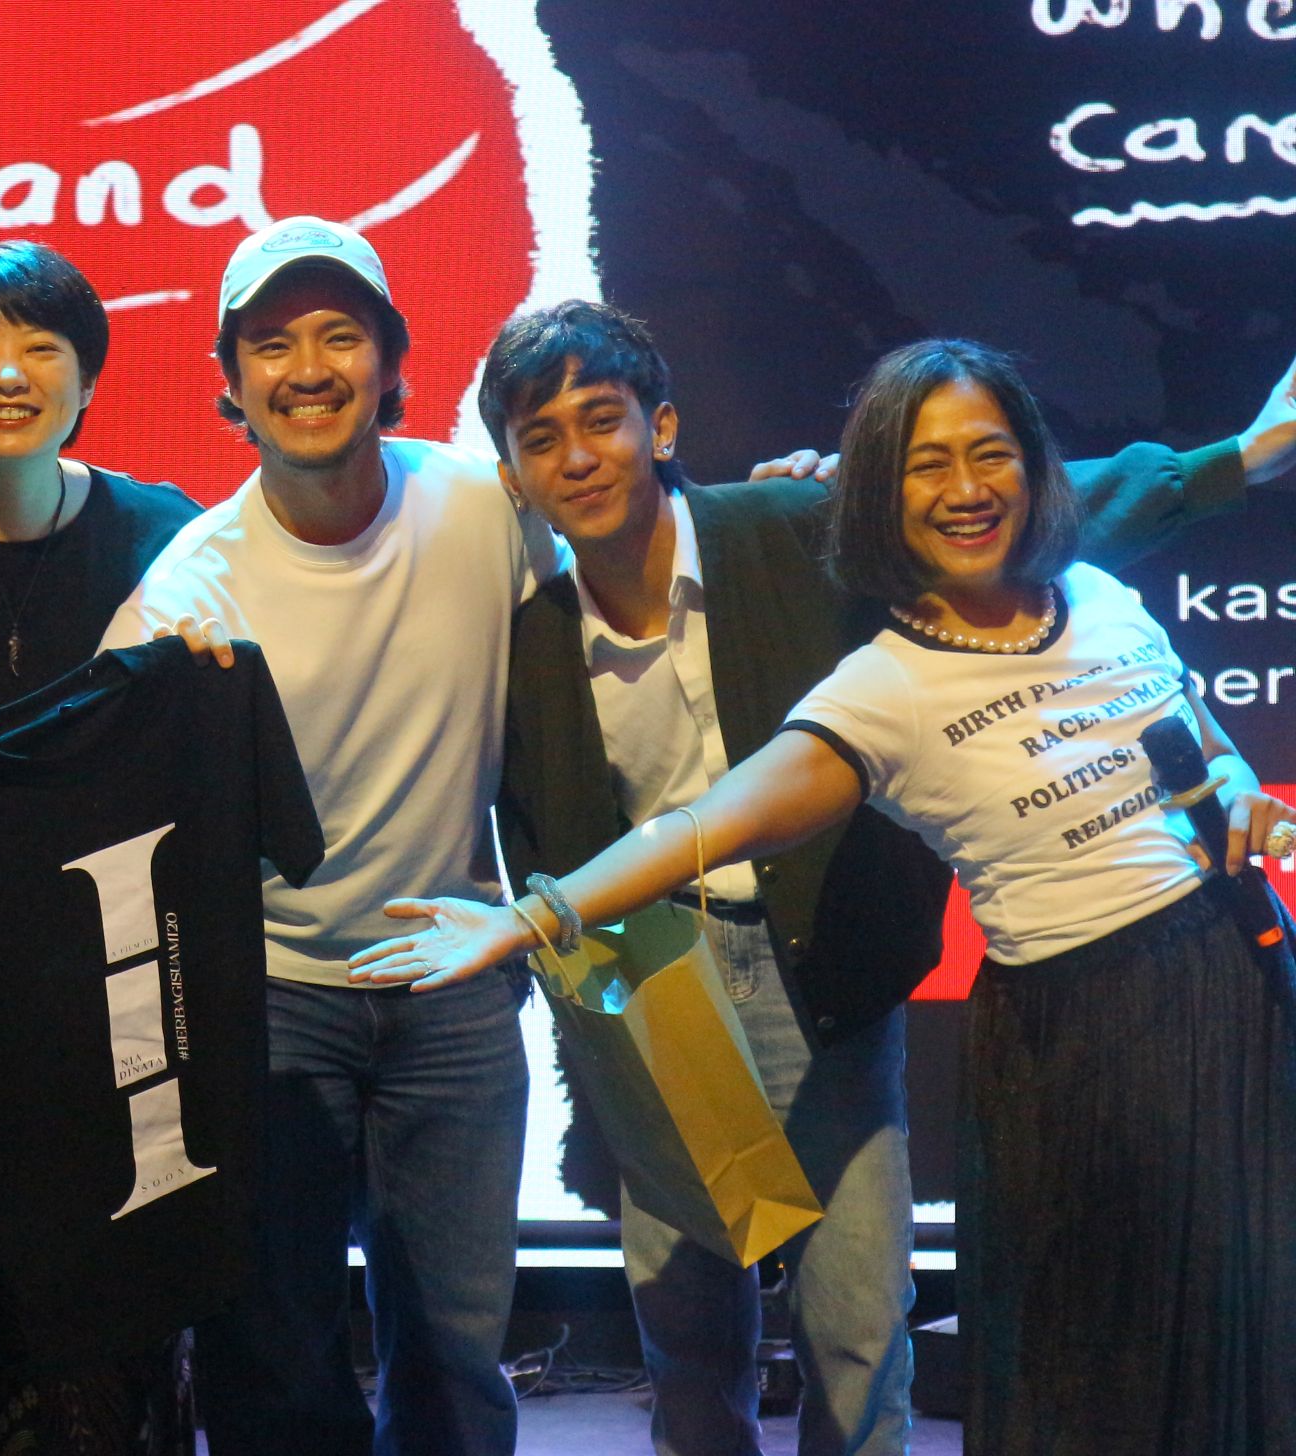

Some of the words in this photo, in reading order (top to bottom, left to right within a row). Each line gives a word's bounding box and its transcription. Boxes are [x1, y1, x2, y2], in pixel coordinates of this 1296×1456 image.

[943, 690, 1027, 747] BIRTH
[1019, 711, 1101, 758] RACE:
[1099, 674, 1173, 718] HUMAN
[1010, 748, 1136, 818] POLITICS:
[165, 912, 190, 1061] #BERBAGISUAMI20
[119, 1057, 163, 1080] DINATA
[121, 1053, 142, 1068] NIA
